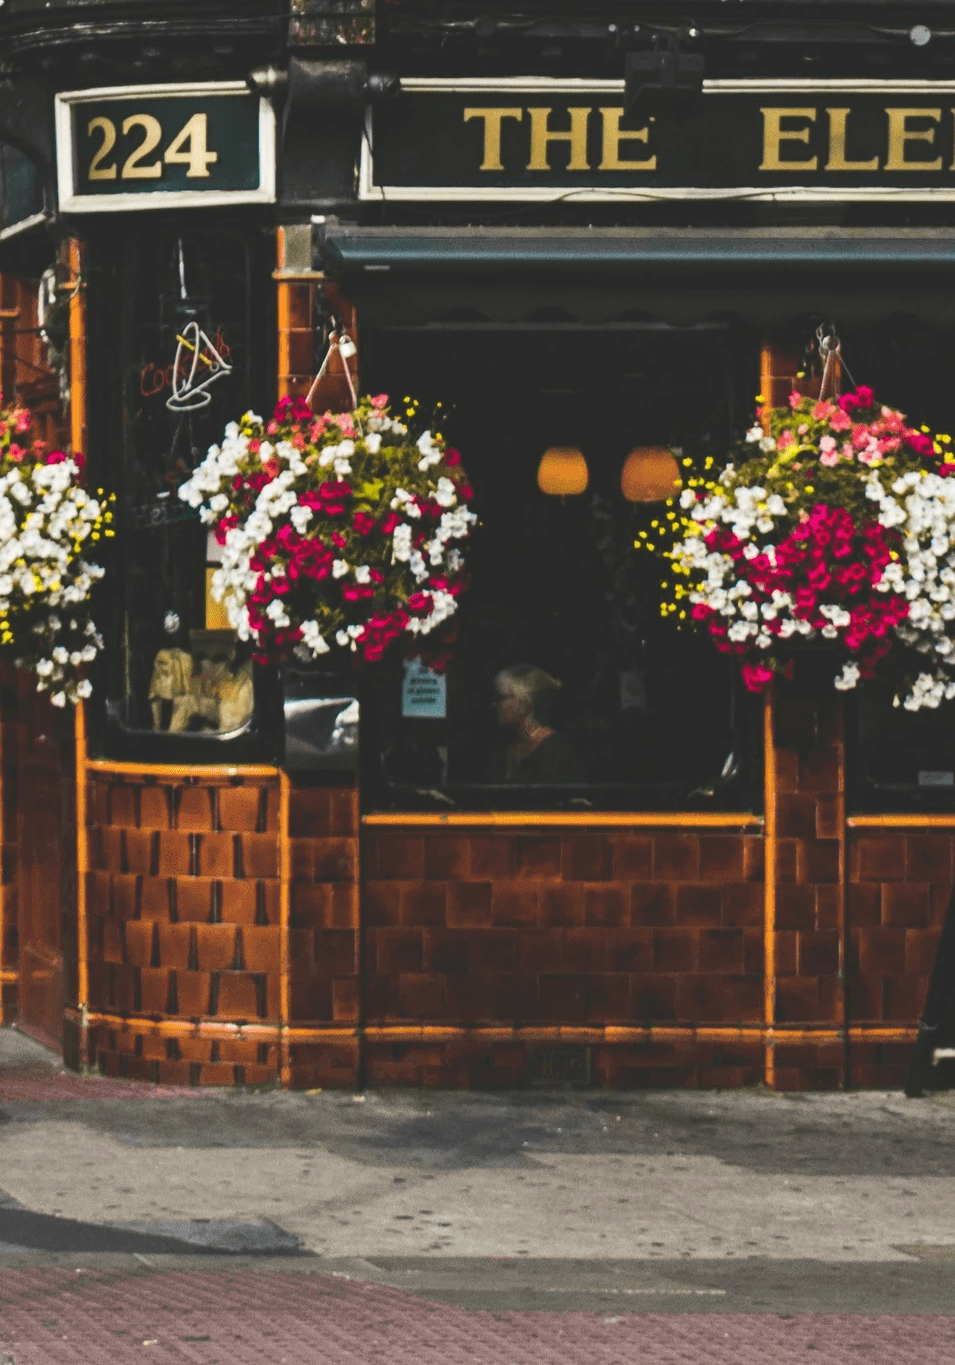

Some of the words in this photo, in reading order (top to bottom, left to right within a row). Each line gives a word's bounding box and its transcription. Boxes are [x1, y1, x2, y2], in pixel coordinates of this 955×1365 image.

[87, 112, 219, 180] 224
[462, 106, 658, 171] THE
[757, 106, 955, 172] ELE
